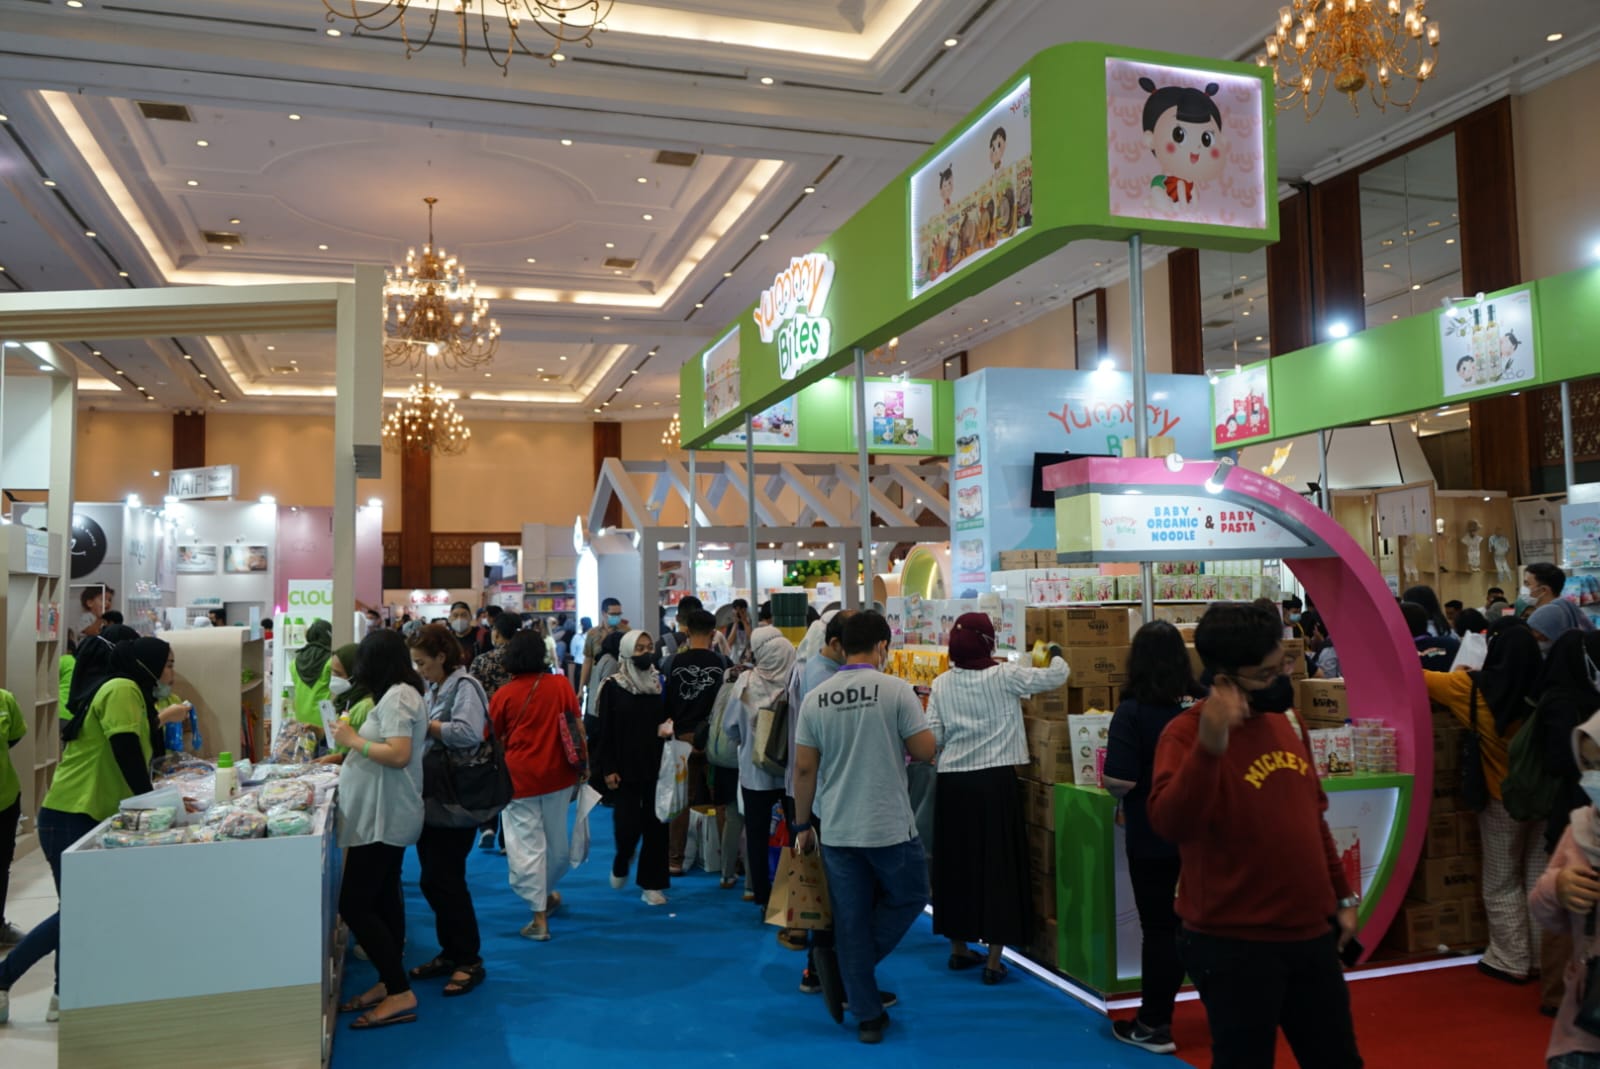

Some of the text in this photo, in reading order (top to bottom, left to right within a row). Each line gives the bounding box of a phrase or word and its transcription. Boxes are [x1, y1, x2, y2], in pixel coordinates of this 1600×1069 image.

[780, 316, 821, 375] Bites
[1048, 400, 1181, 437] Yummy
[1154, 505, 1190, 517] BABY
[1219, 511, 1255, 522] BABY
[1146, 517, 1199, 530] ORGANIC
[1204, 514, 1215, 530] &
[1220, 521, 1257, 533] PASTA
[1151, 530, 1196, 542] NOODLE
[818, 684, 879, 708] HODL!
[1243, 751, 1309, 789] MICKEY
